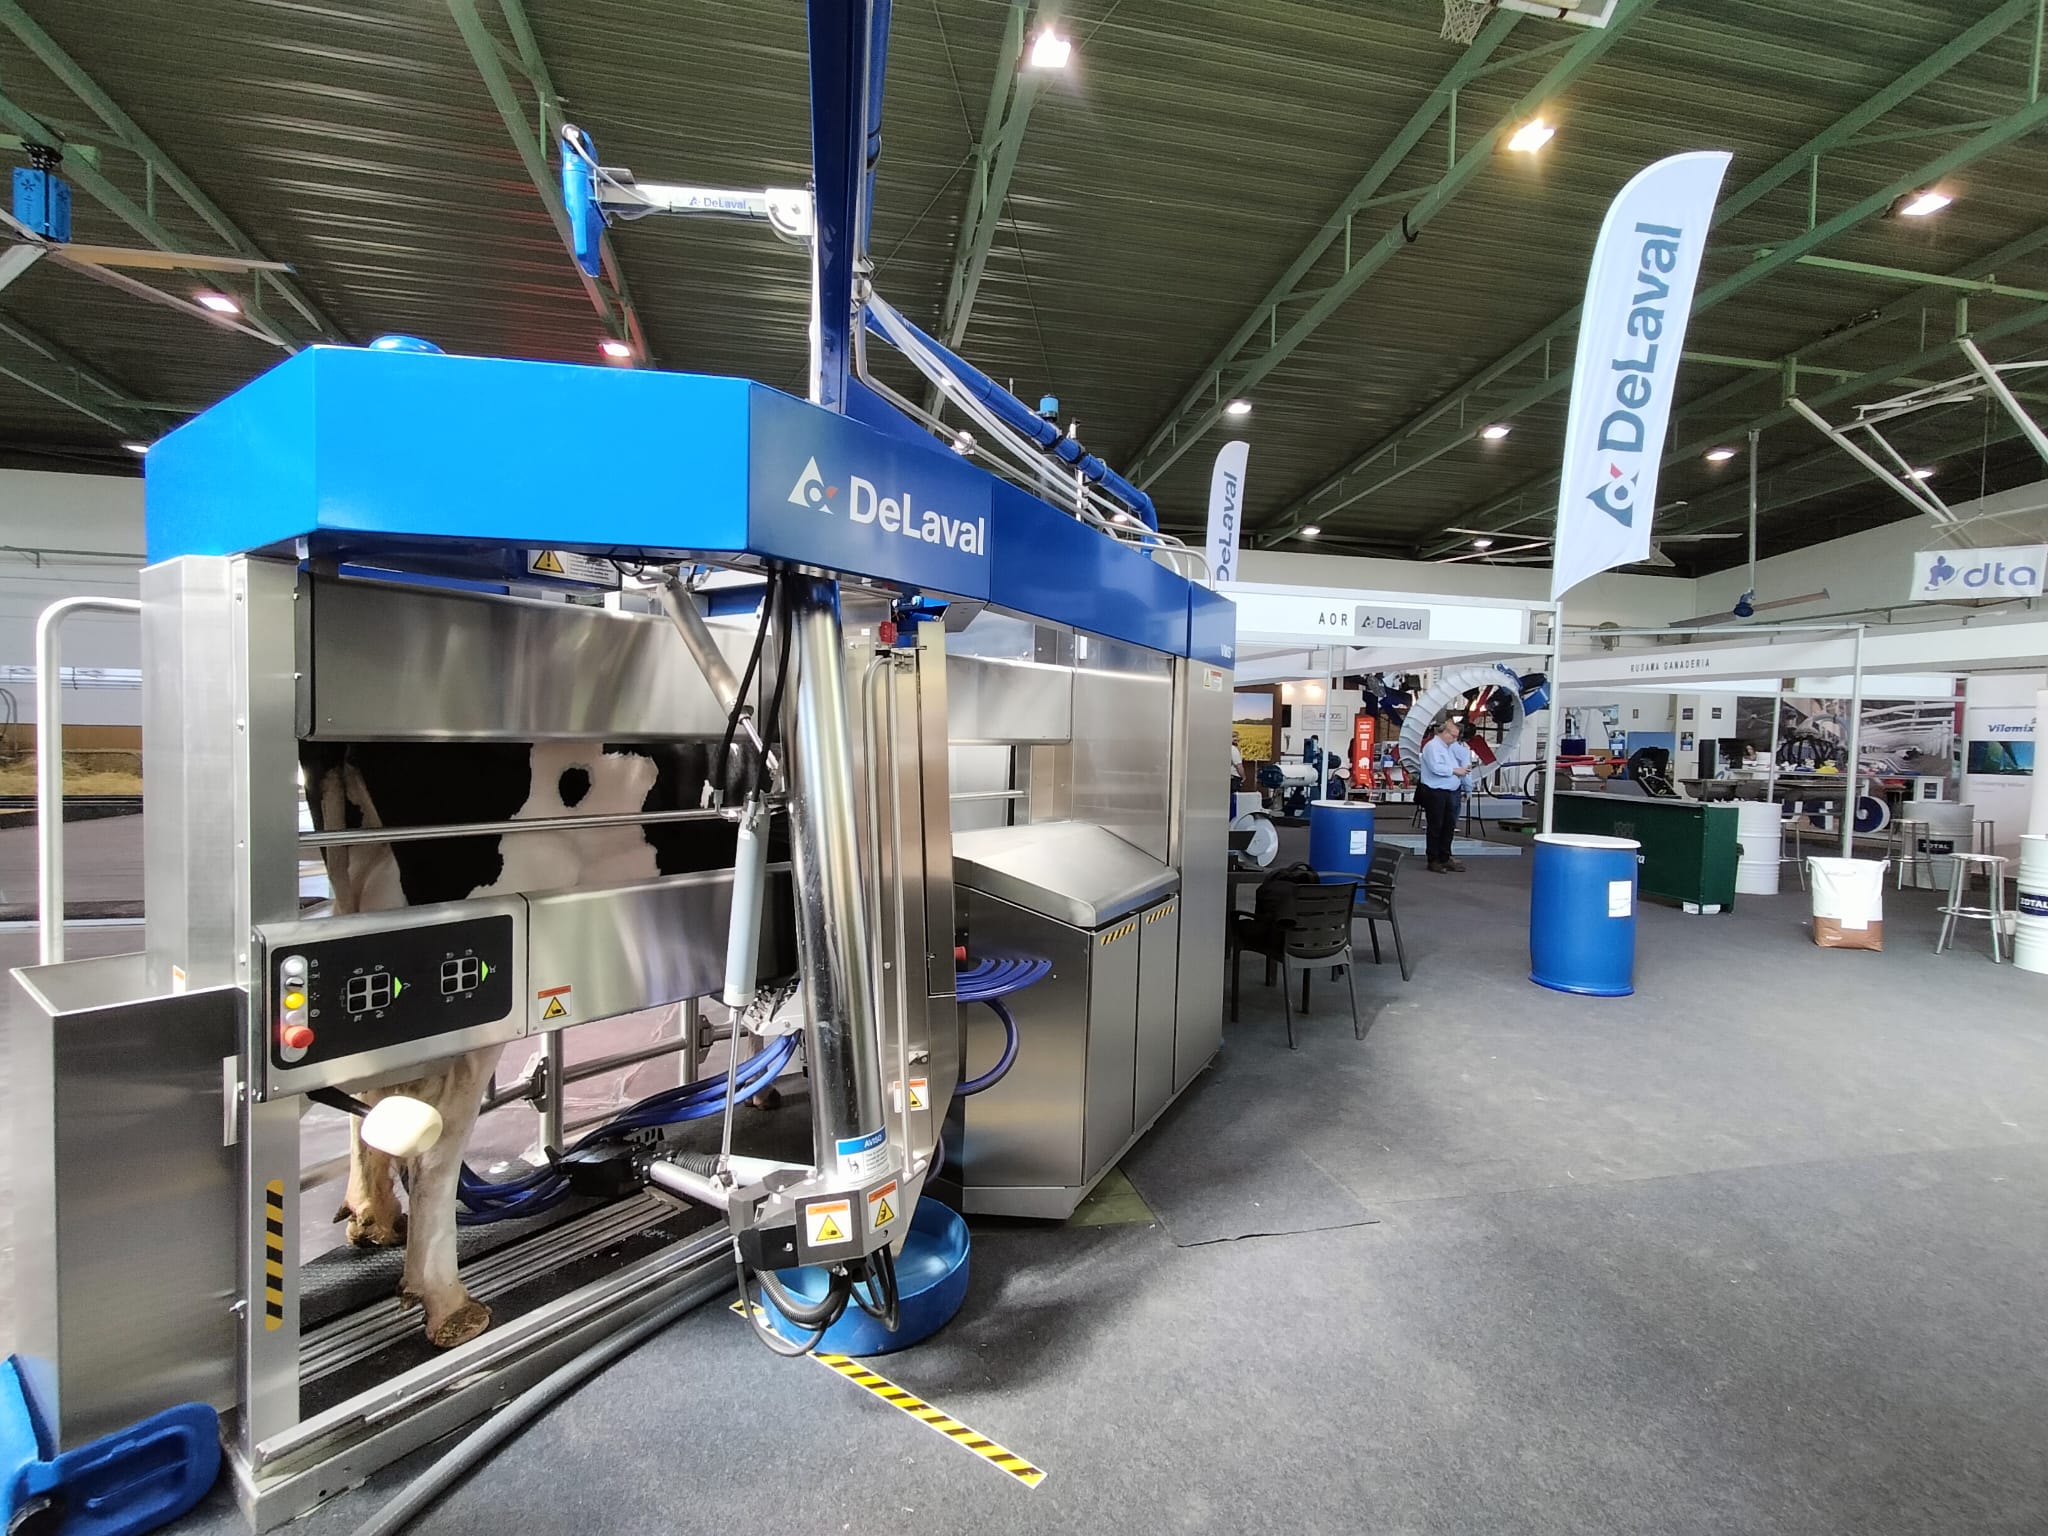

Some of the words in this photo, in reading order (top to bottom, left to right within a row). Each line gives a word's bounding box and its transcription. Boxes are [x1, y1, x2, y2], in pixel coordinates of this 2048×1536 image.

[703, 197, 746, 210] DeLaval
[1598, 222, 1683, 453] DeLaval
[849, 474, 985, 556] DeLaval
[1216, 471, 1238, 582] DeLaval
[1963, 562, 2037, 588] dta
[1376, 616, 1422, 631] DeLaval
